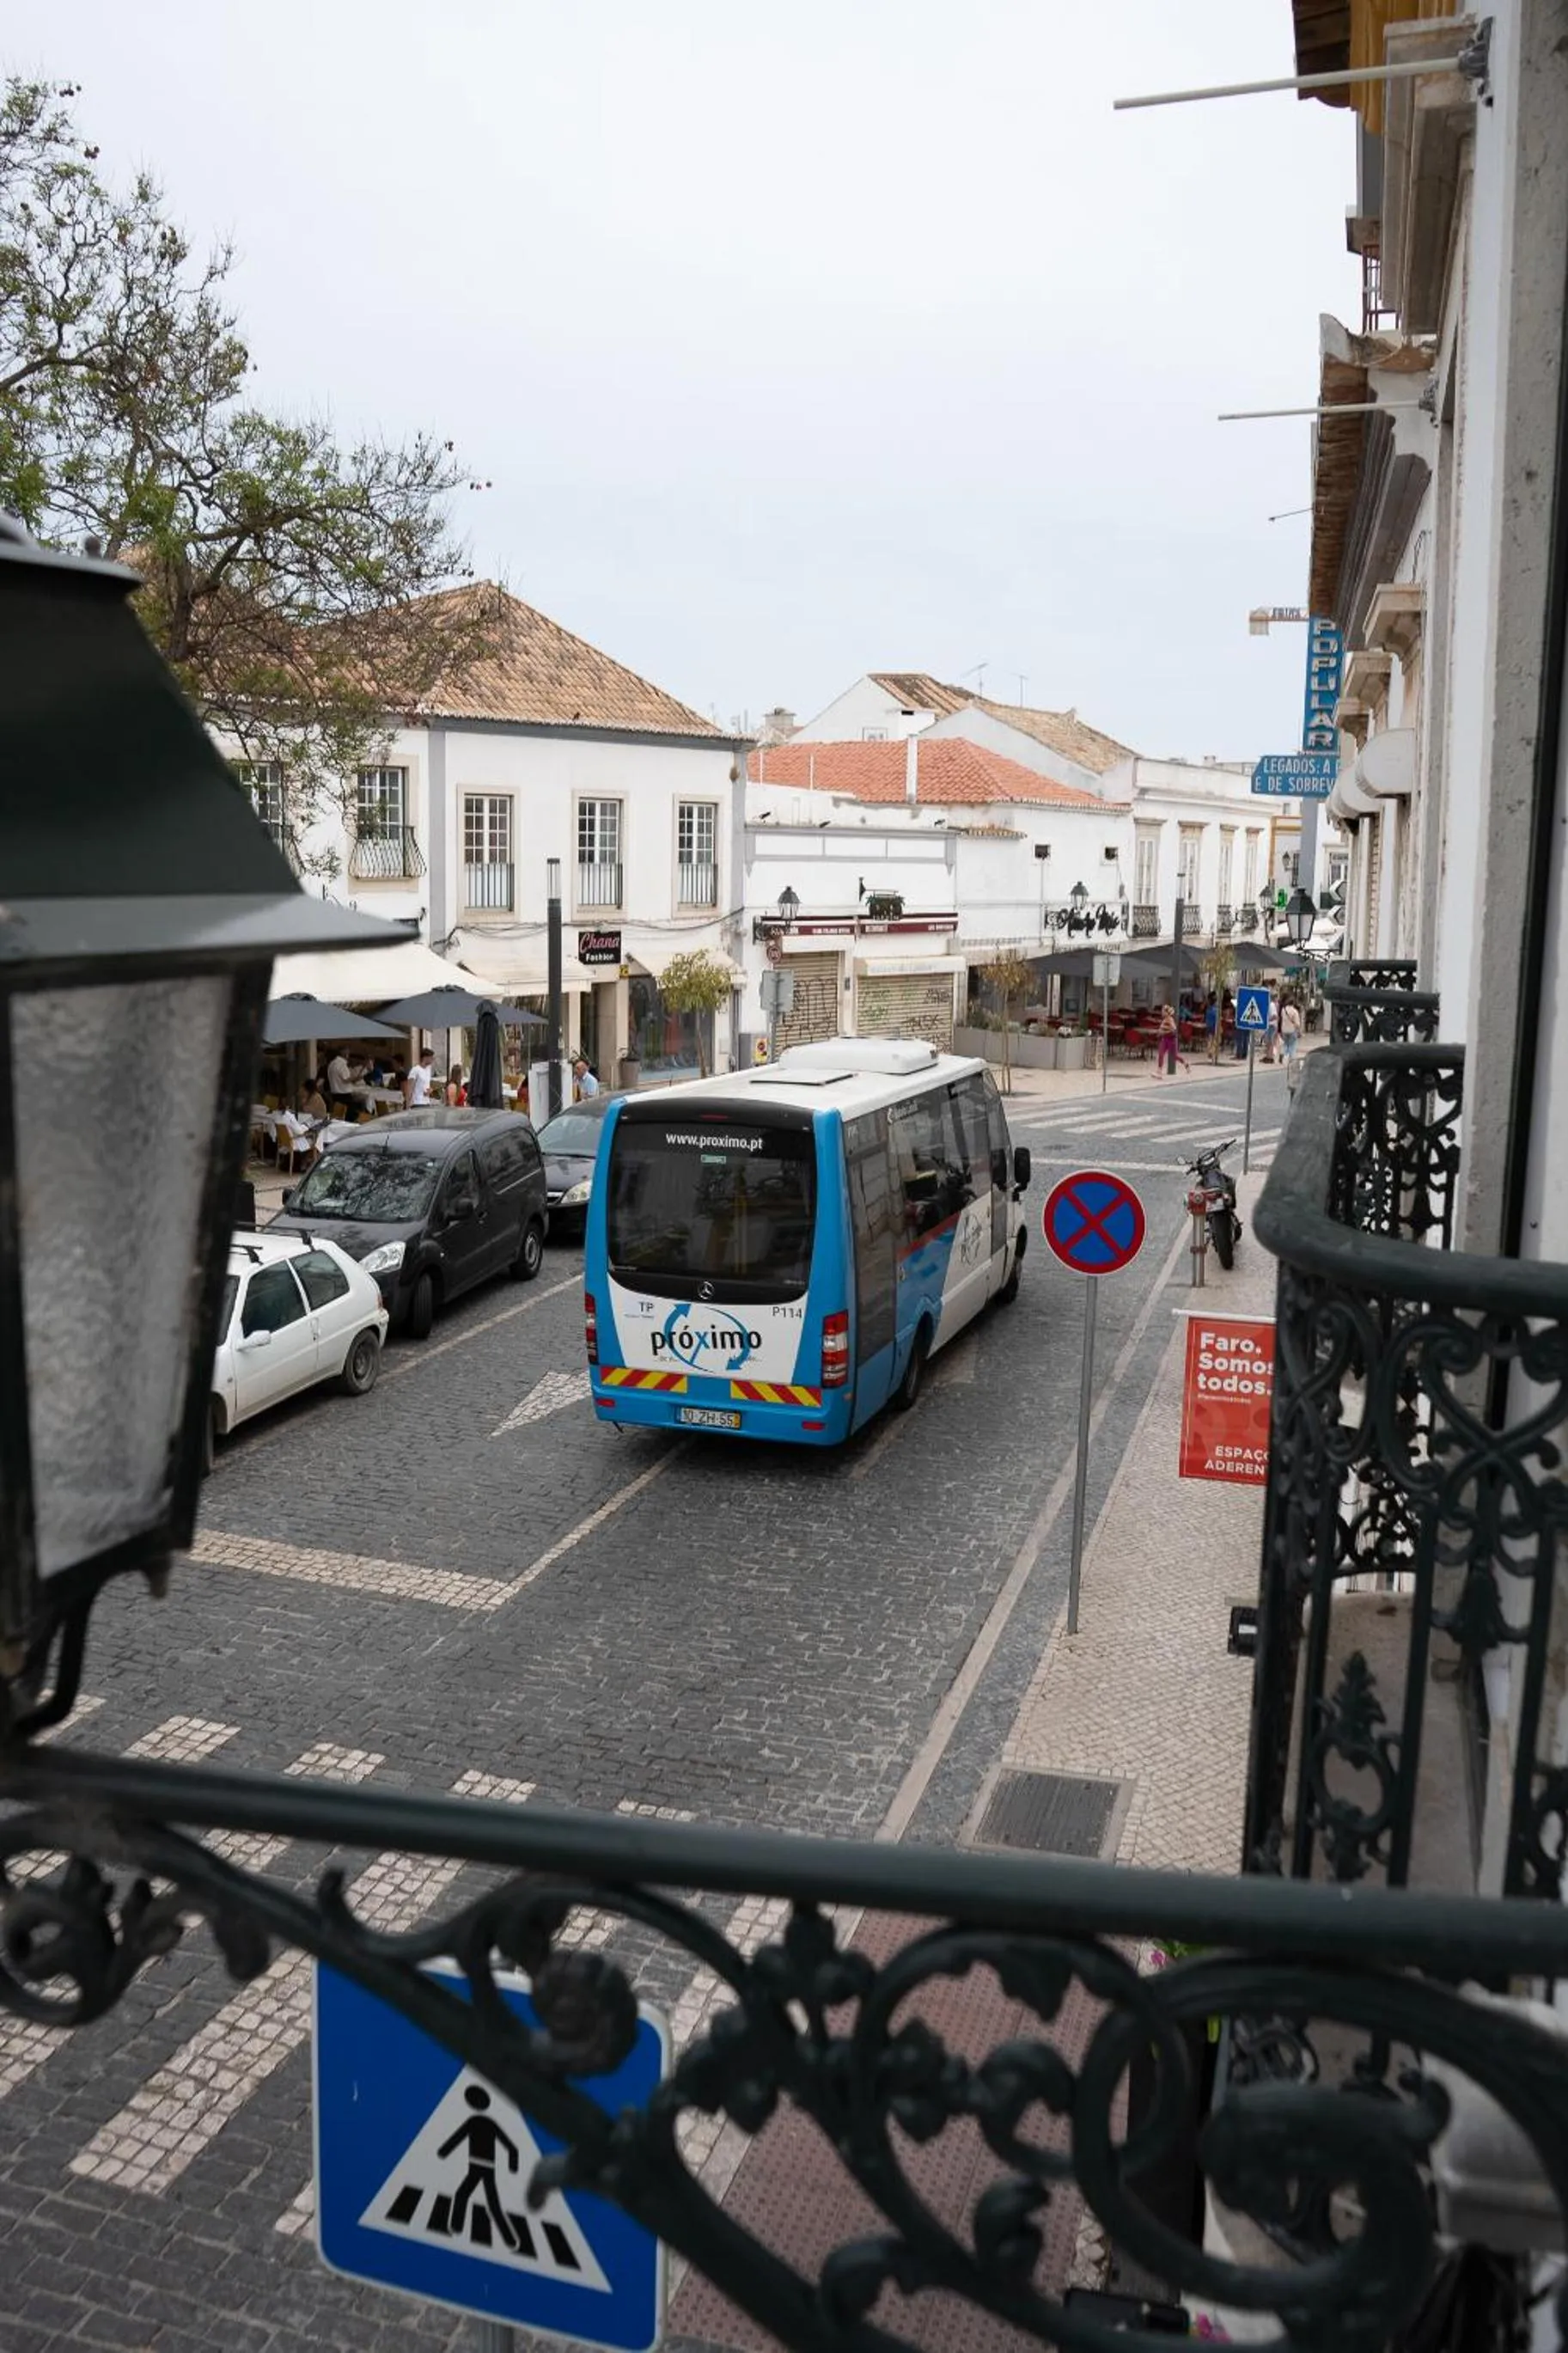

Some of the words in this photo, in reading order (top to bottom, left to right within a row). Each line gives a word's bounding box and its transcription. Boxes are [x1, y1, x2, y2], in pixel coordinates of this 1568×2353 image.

[1308, 618, 1338, 747] POPULAR
[1263, 757, 1321, 774] LEGADOS:
[1323, 759, 1331, 774] A
[1255, 776, 1262, 791] E
[1268, 776, 1283, 791] DE
[665, 1134, 763, 1152] www.proximo.pt
[638, 1301, 655, 1312] TP
[772, 1306, 802, 1318] P114
[650, 1324, 762, 1356] próximo
[1200, 1331, 1262, 1354] Faro.
[1198, 1372, 1272, 1396] todos.
[1205, 1458, 1268, 1476] ADEREN
